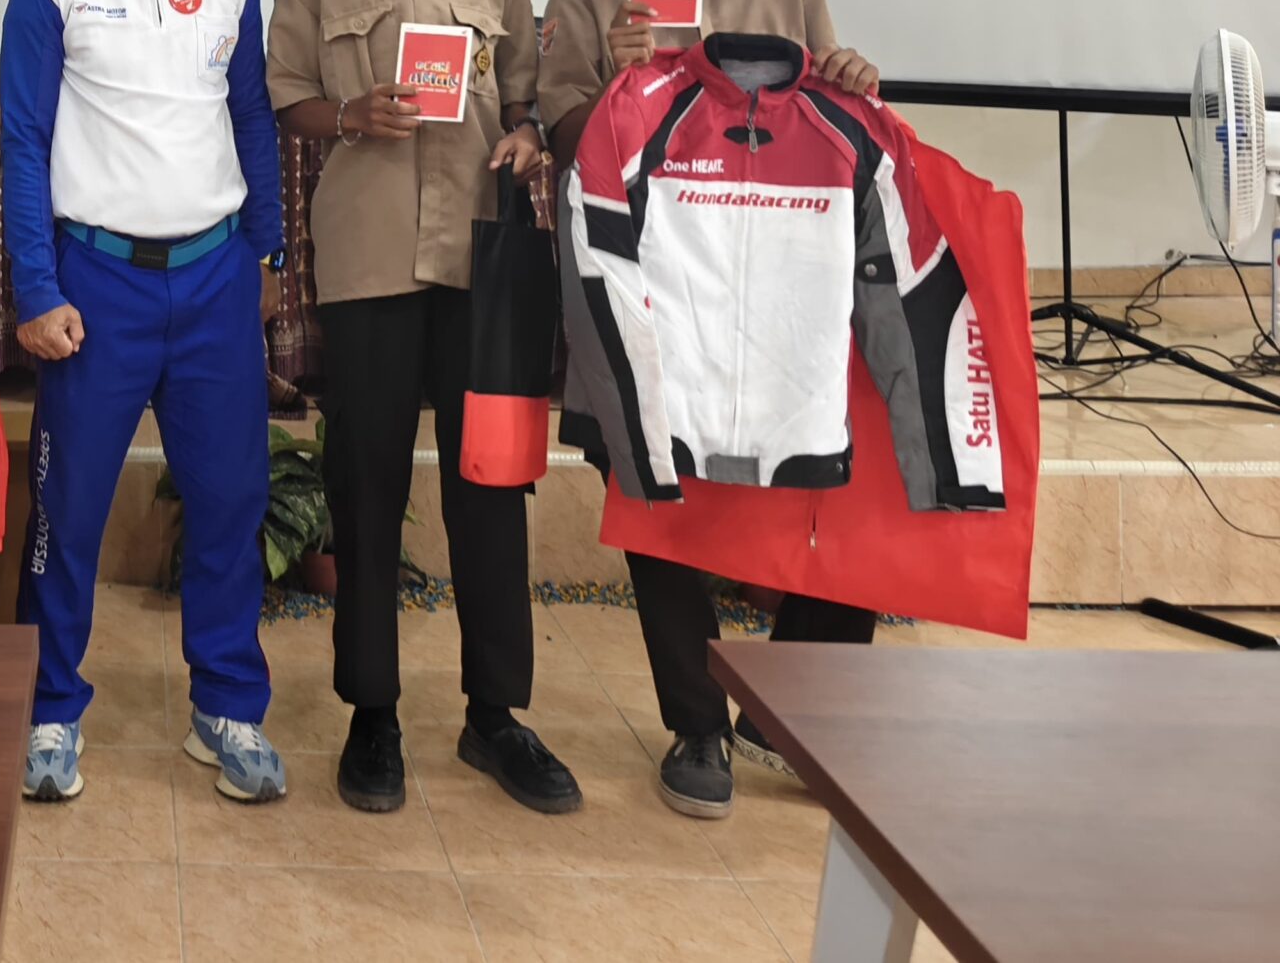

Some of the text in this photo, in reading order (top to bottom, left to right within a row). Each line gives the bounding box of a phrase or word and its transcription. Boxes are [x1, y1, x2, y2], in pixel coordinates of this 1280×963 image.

[662, 158, 690, 173] One
[676, 189, 831, 214] HondaRacing
[966, 391, 992, 448] Satu
